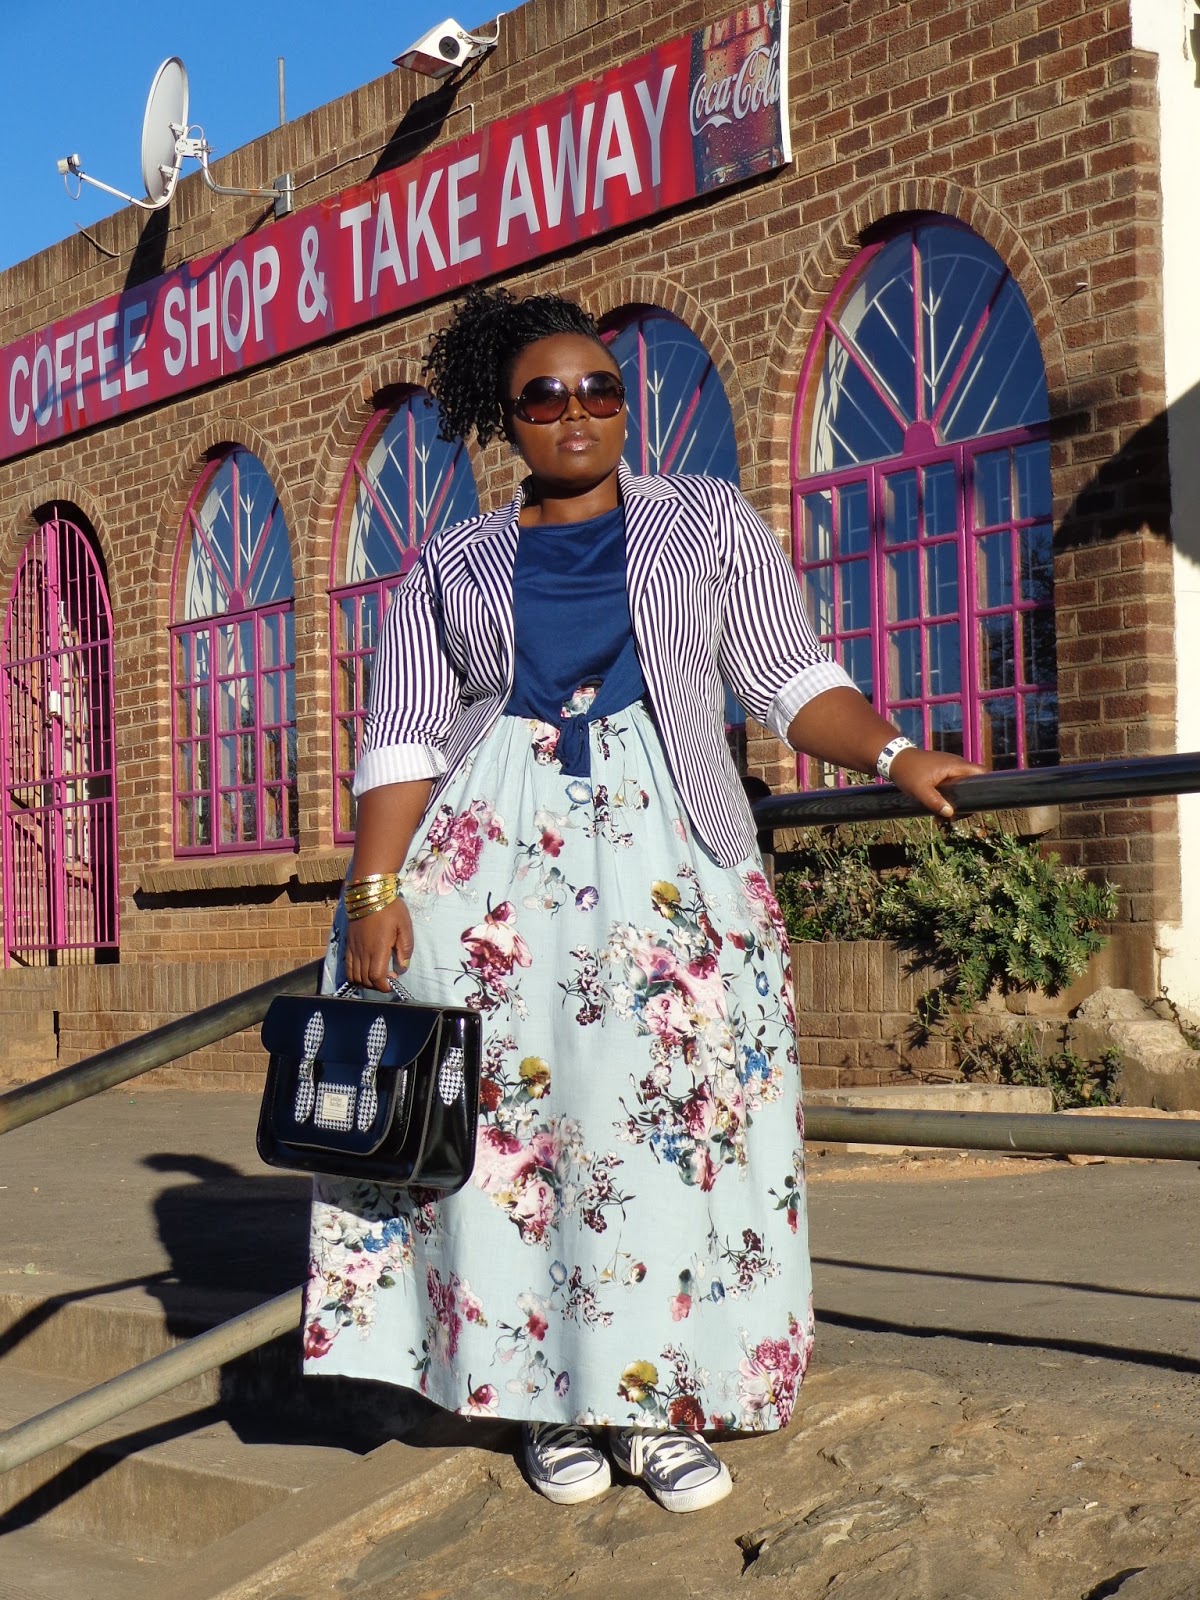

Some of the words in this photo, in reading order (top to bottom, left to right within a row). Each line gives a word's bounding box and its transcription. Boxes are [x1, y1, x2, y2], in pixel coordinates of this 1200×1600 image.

[689, 41, 780, 137] Coca-Cola
[9, 300, 149, 436] COFFEE
[163, 245, 281, 376] SHOP
[297, 225, 328, 324] &
[340, 153, 482, 303] TAKE
[496, 64, 677, 247] AWAY
